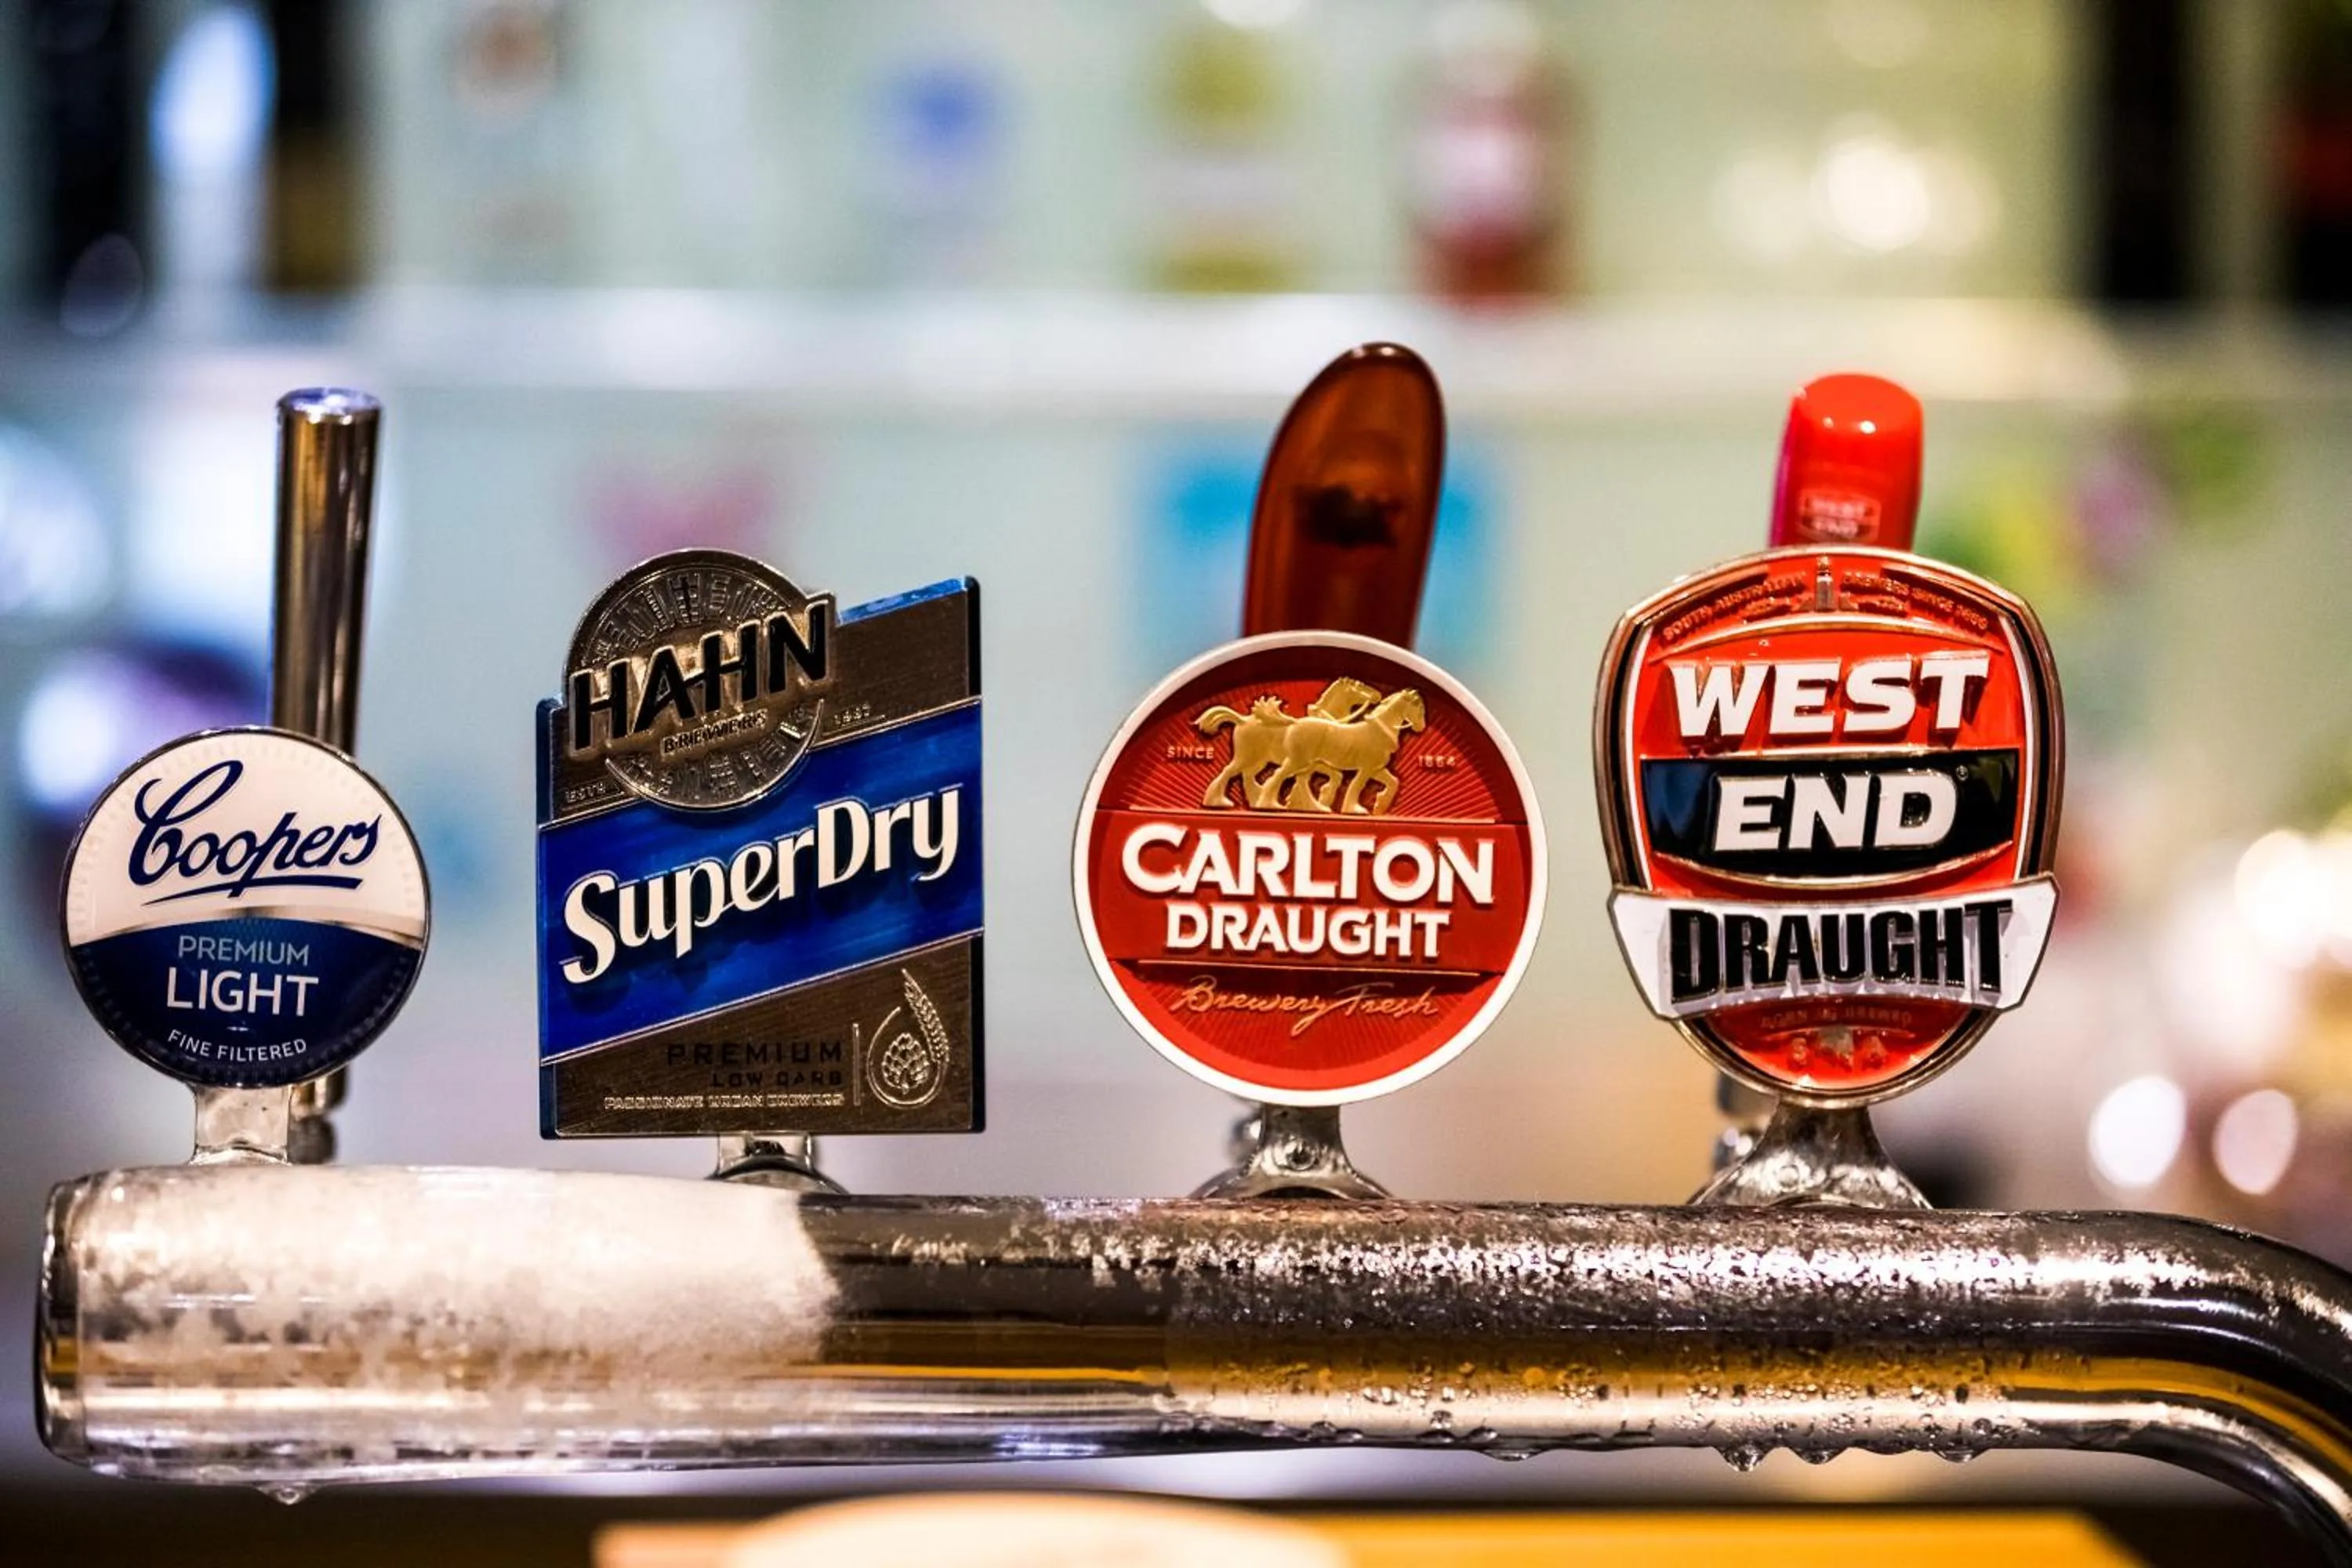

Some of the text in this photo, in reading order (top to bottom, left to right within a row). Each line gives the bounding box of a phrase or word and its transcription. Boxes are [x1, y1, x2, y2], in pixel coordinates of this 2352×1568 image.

[568, 599, 831, 753] HAHN
[1668, 651, 1990, 738] WEST
[1167, 746, 1215, 760] SINCE
[128, 760, 383, 898] Coopers
[1714, 769, 1957, 851] END
[1121, 822, 1495, 905] CARLTON
[178, 935, 309, 966] PREMIUM
[1166, 902, 1450, 958] DRAUGHT
[1669, 898, 2013, 1005] DRAUGHT
[167, 967, 319, 1016] LIGHT
[1170, 975, 1439, 1037] Brewery Fresh
[168, 1029, 307, 1062] FINE FILTERED
[667, 1041, 842, 1065] PREMIUM
[712, 1071, 764, 1088] LOW
